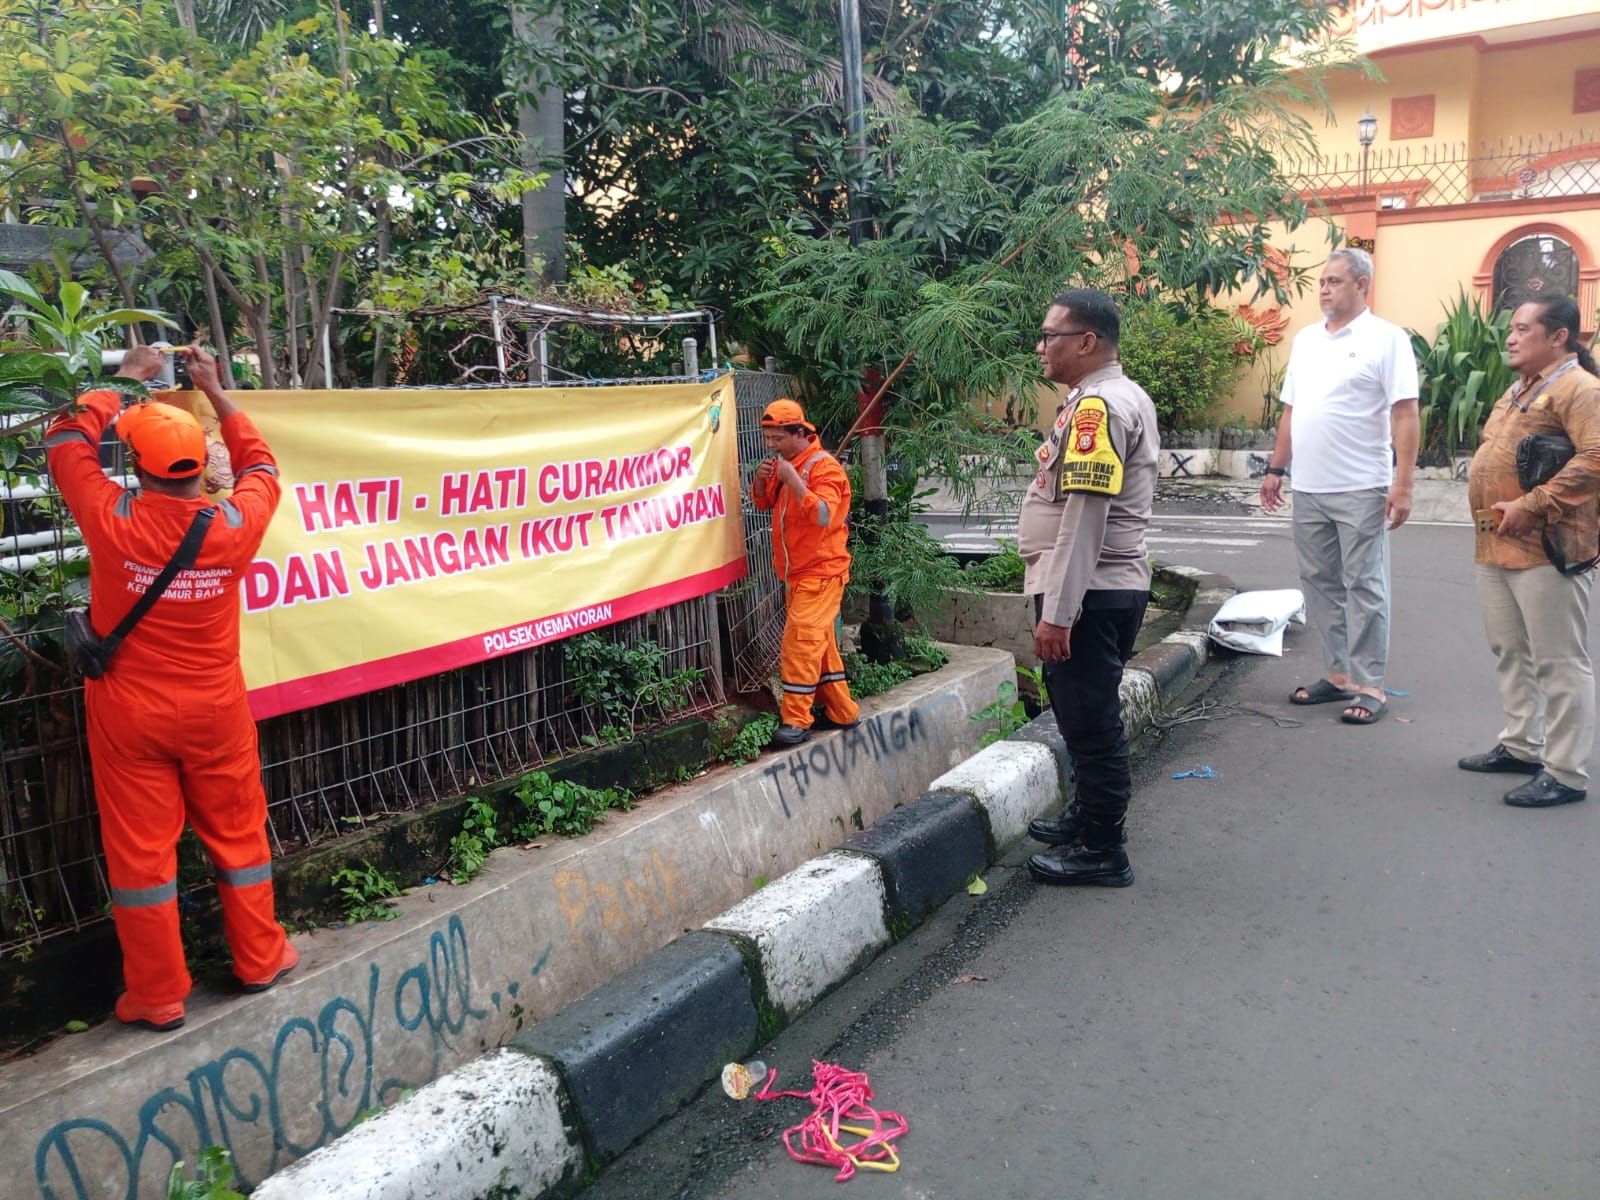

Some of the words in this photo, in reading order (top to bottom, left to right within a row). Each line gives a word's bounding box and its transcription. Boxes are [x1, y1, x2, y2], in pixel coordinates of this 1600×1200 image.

[294, 478, 401, 533] HATI
[439, 465, 528, 517] HATI
[537, 444, 695, 504] CURANMOR
[243, 549, 351, 613] DAN
[358, 523, 512, 592] JANGAN
[519, 510, 595, 559] IKUT
[599, 483, 727, 542] TAWURAN
[135, 574, 155, 585] DAN
[195, 578, 220, 587] UMUM
[183, 568, 233, 579] PRASARANA
[195, 587, 225, 599] BATU
[483, 624, 536, 654] POLSEK
[535, 604, 613, 639] KEMAYORAN
